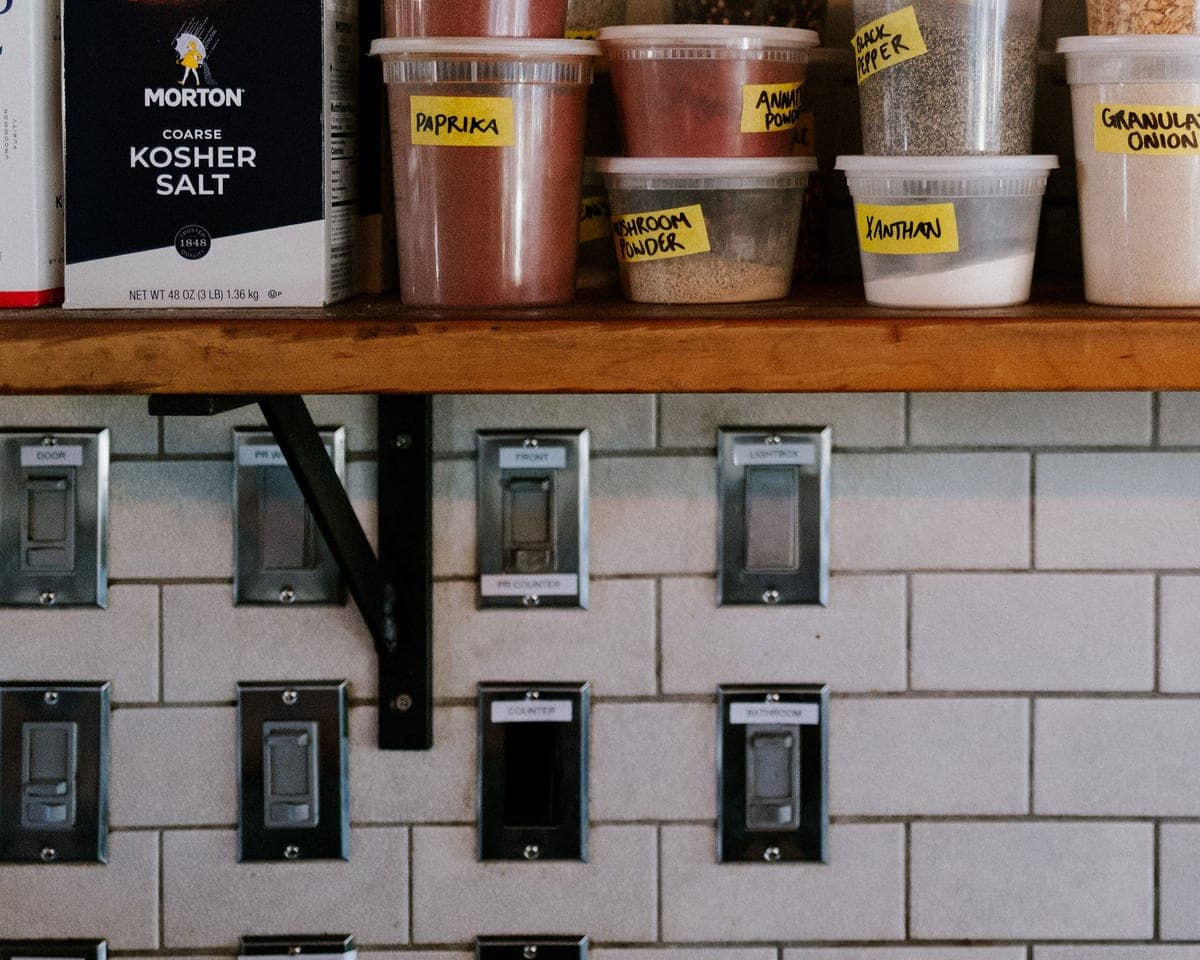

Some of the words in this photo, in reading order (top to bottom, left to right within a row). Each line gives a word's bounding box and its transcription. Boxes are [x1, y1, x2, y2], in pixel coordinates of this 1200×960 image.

[144, 88, 242, 107] MORTON
[162, 129, 222, 140] COARSE
[416, 112, 499, 136] PAPRIKA
[1127, 130, 1199, 151] ONION
[130, 146, 257, 168] KOSHER
[156, 173, 230, 196] SALT
[613, 212, 692, 237] USHROOM
[865, 215, 942, 241] XANTHAN
[180, 239, 207, 248] 1848
[619, 233, 685, 259] POWDER
[129, 290, 147, 300] NET
[150, 290, 165, 300] WT
[168, 290, 180, 300] 48
[183, 290, 195, 300] OZ
[198, 290, 206, 301] (3
[209, 290, 224, 301] LB)
[227, 290, 246, 300] 1.36
[248, 290, 259, 301] kg
